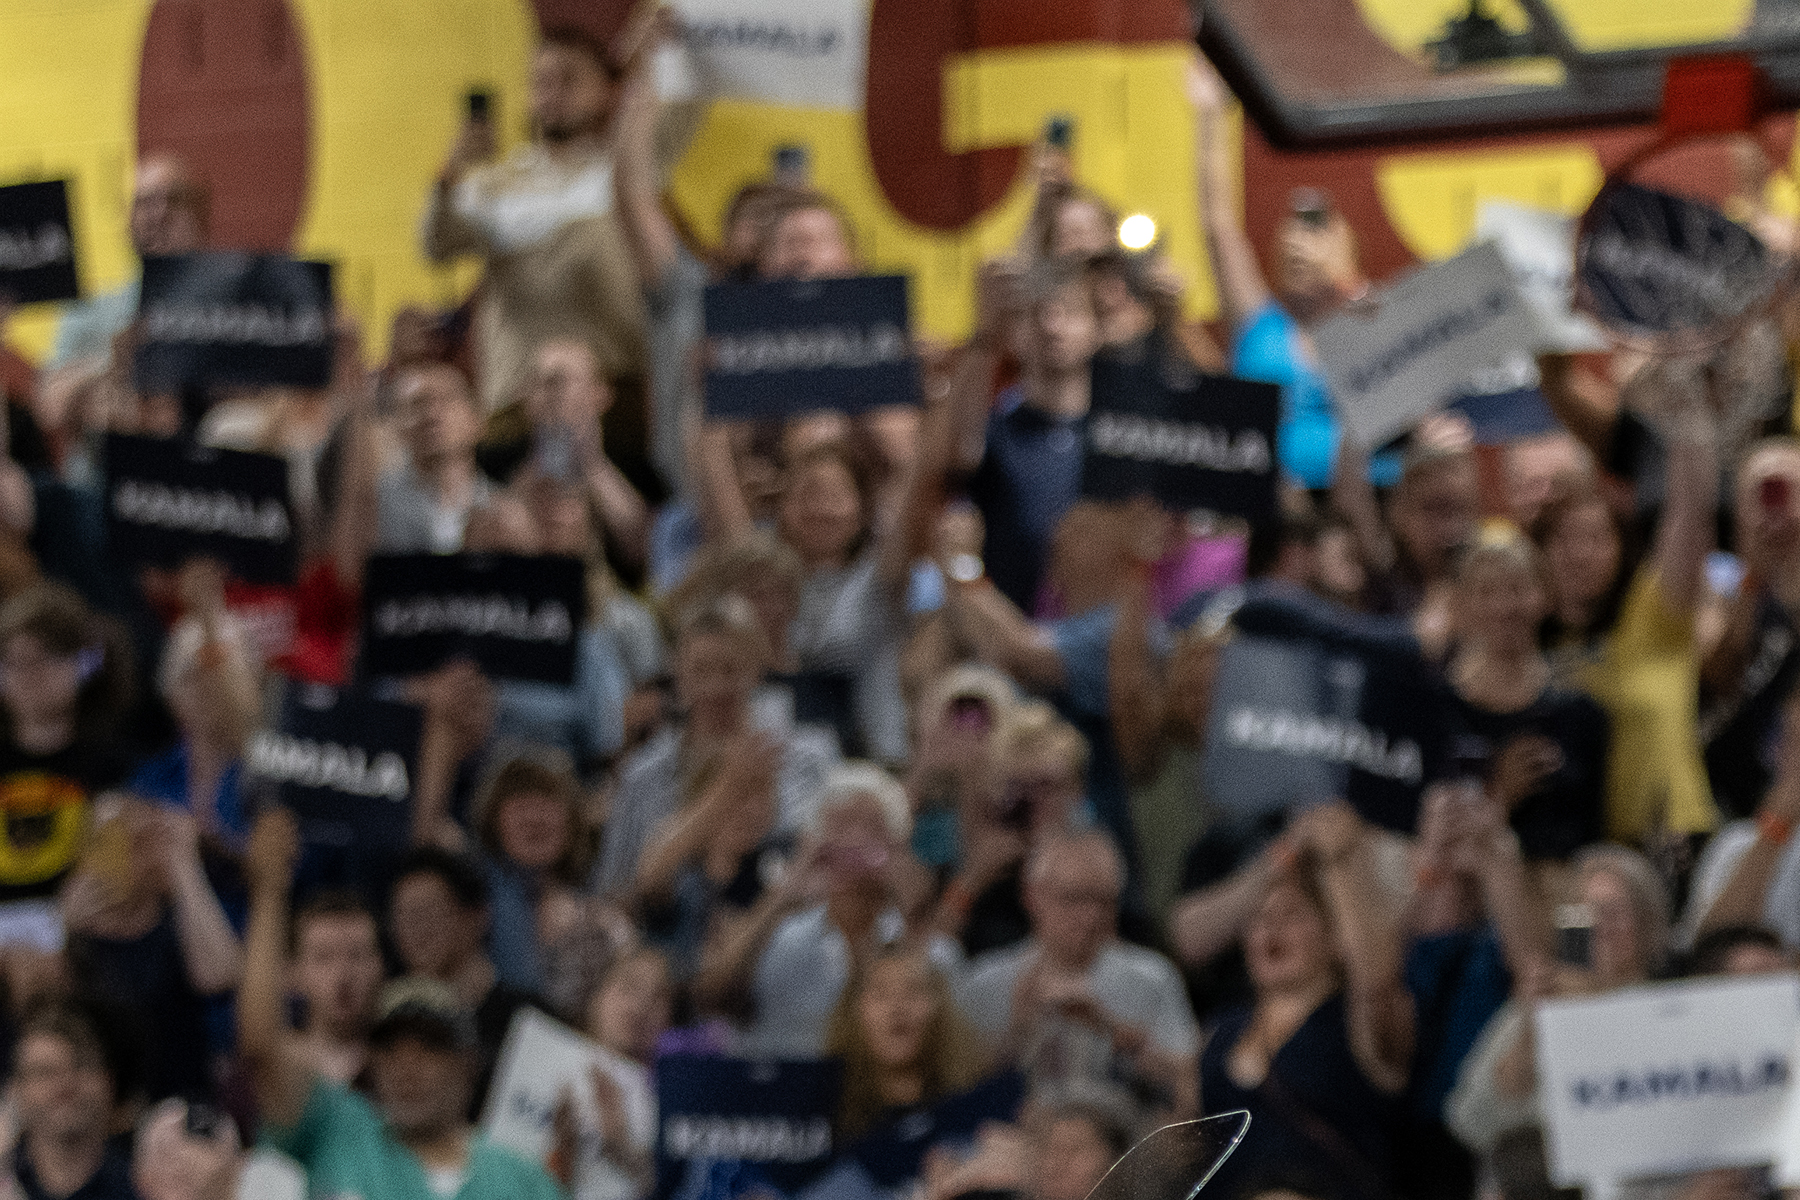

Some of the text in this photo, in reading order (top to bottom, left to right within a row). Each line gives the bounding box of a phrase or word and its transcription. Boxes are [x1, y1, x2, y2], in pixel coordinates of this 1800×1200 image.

[1086, 413, 1271, 473] KAMALA
[112, 478, 290, 541] KAMALA
[374, 594, 573, 645] KAMALA
[1226, 704, 1423, 781] KAMALA
[1573, 1056, 1789, 1114] KAMALA
